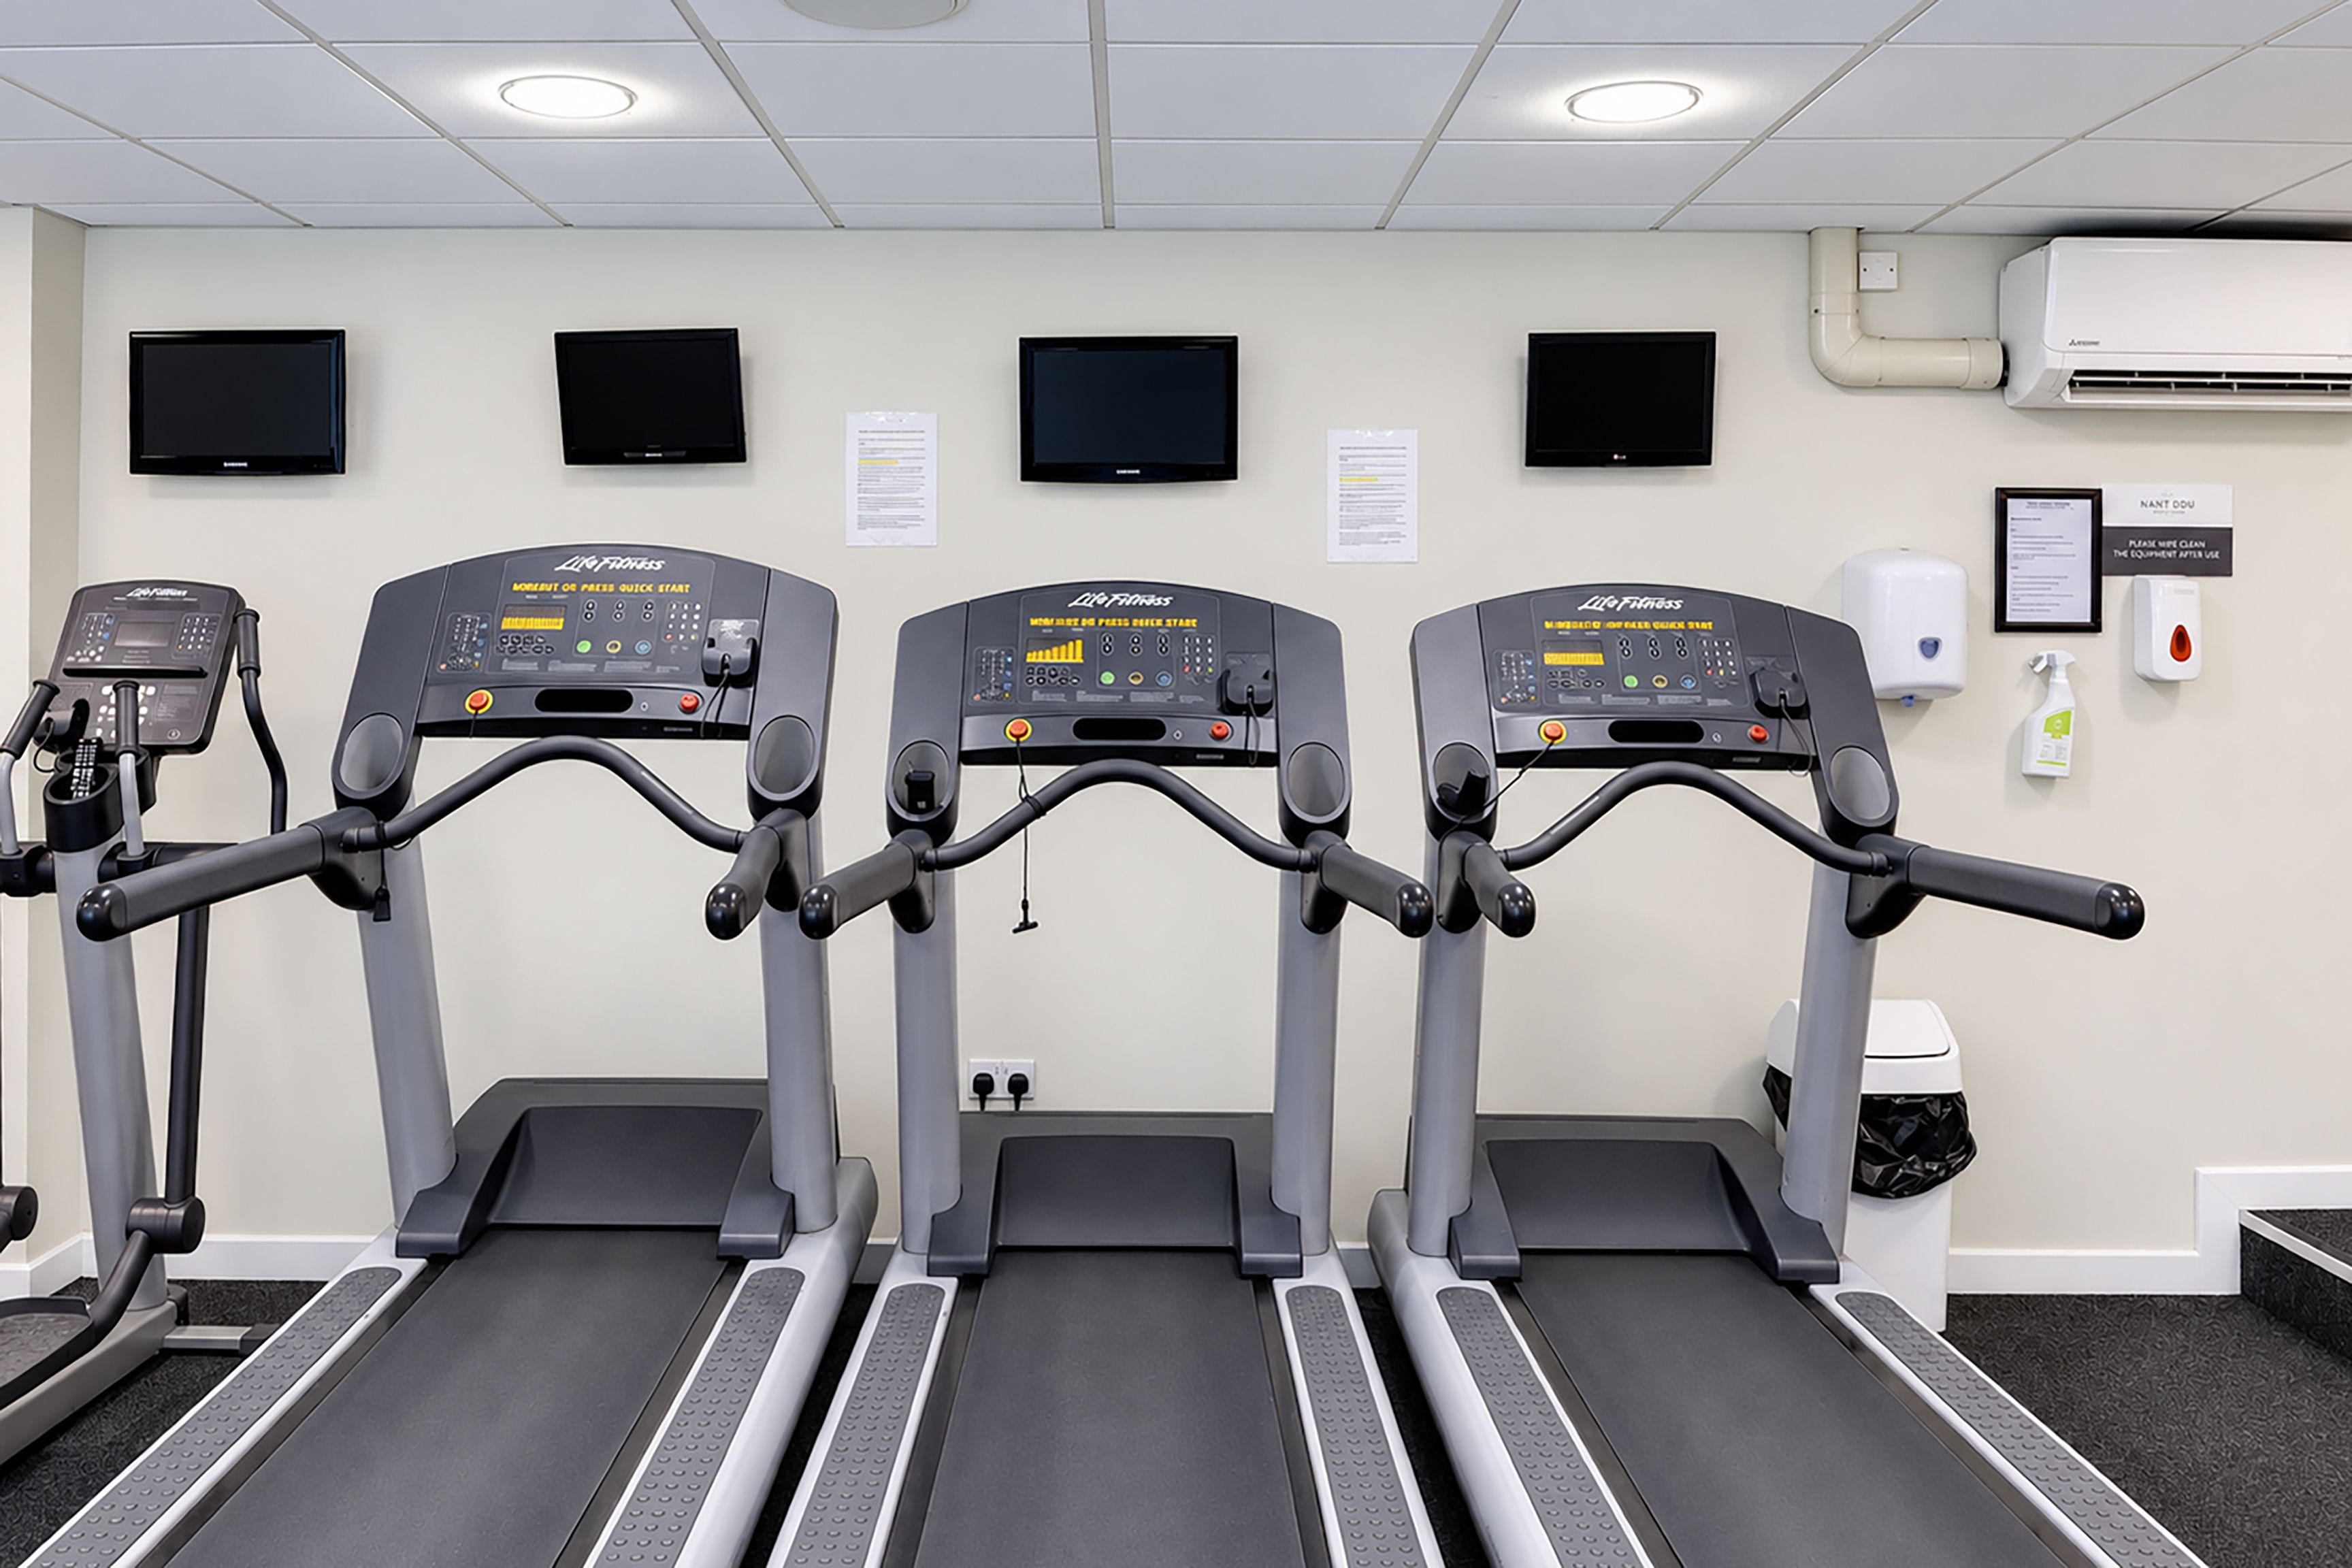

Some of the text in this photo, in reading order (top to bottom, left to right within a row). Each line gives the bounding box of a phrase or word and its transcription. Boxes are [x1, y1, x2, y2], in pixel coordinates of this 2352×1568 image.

[2140, 500, 2195, 509] NANT DDU
[2129, 539, 2206, 549] PLEASE WIPE CLEAN
[2113, 549, 2220, 559] THE EQUIPMENT AFTER USE
[555, 555, 666, 572] Life Fitness
[619, 584, 653, 593] QUICK
[658, 584, 691, 594] START
[1068, 592, 1173, 608] Life Fitness
[1578, 595, 1684, 611] Life Fitness
